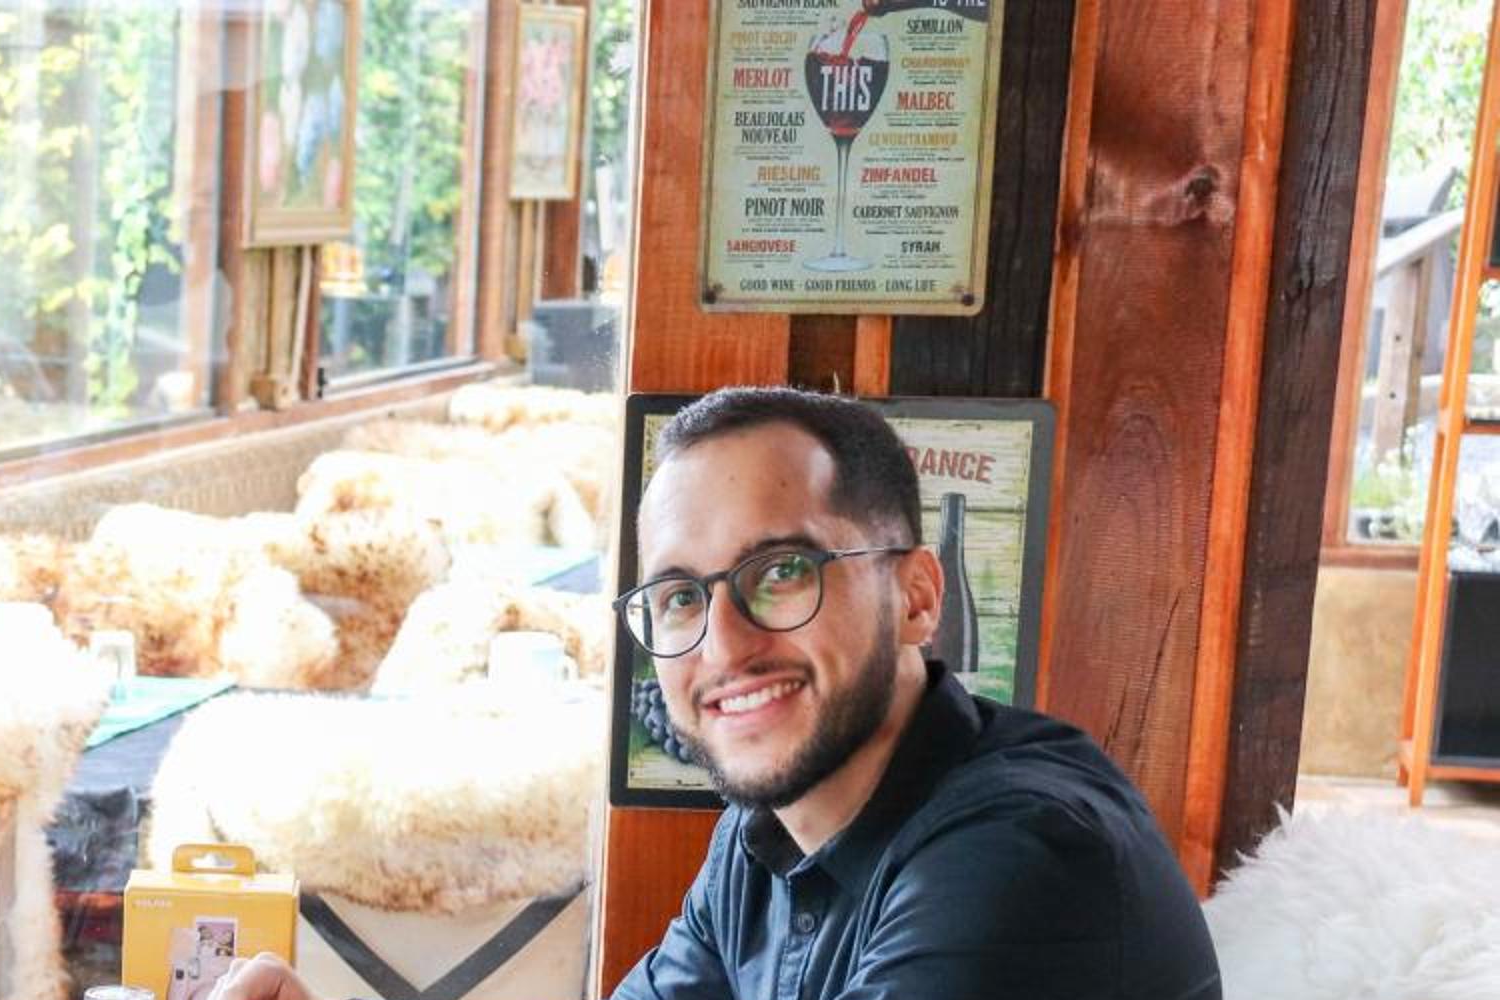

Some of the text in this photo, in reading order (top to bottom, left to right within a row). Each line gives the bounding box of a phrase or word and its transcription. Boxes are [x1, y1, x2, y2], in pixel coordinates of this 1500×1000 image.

[733, 67, 792, 89] MERLOT
[820, 65, 873, 112] THIS
[896, 91, 955, 111] MALBEC
[734, 111, 805, 127] BEAUJOLAIS
[741, 127, 797, 144] NOUVEAU
[757, 165, 821, 182] RIESLING
[861, 167, 939, 183] ZINFANDEL
[745, 197, 825, 217] PINOT NOIR
[853, 205, 960, 218] CABERNET SAUVIGNON
[726, 239, 797, 253] SANGIOVESE
[901, 241, 941, 253] SYRAH
[740, 279, 768, 292] GOOD
[771, 279, 796, 292] WINE
[804, 279, 833, 292] GOOD
[835, 279, 877, 292] FRIENDS
[885, 279, 913, 292] LONG
